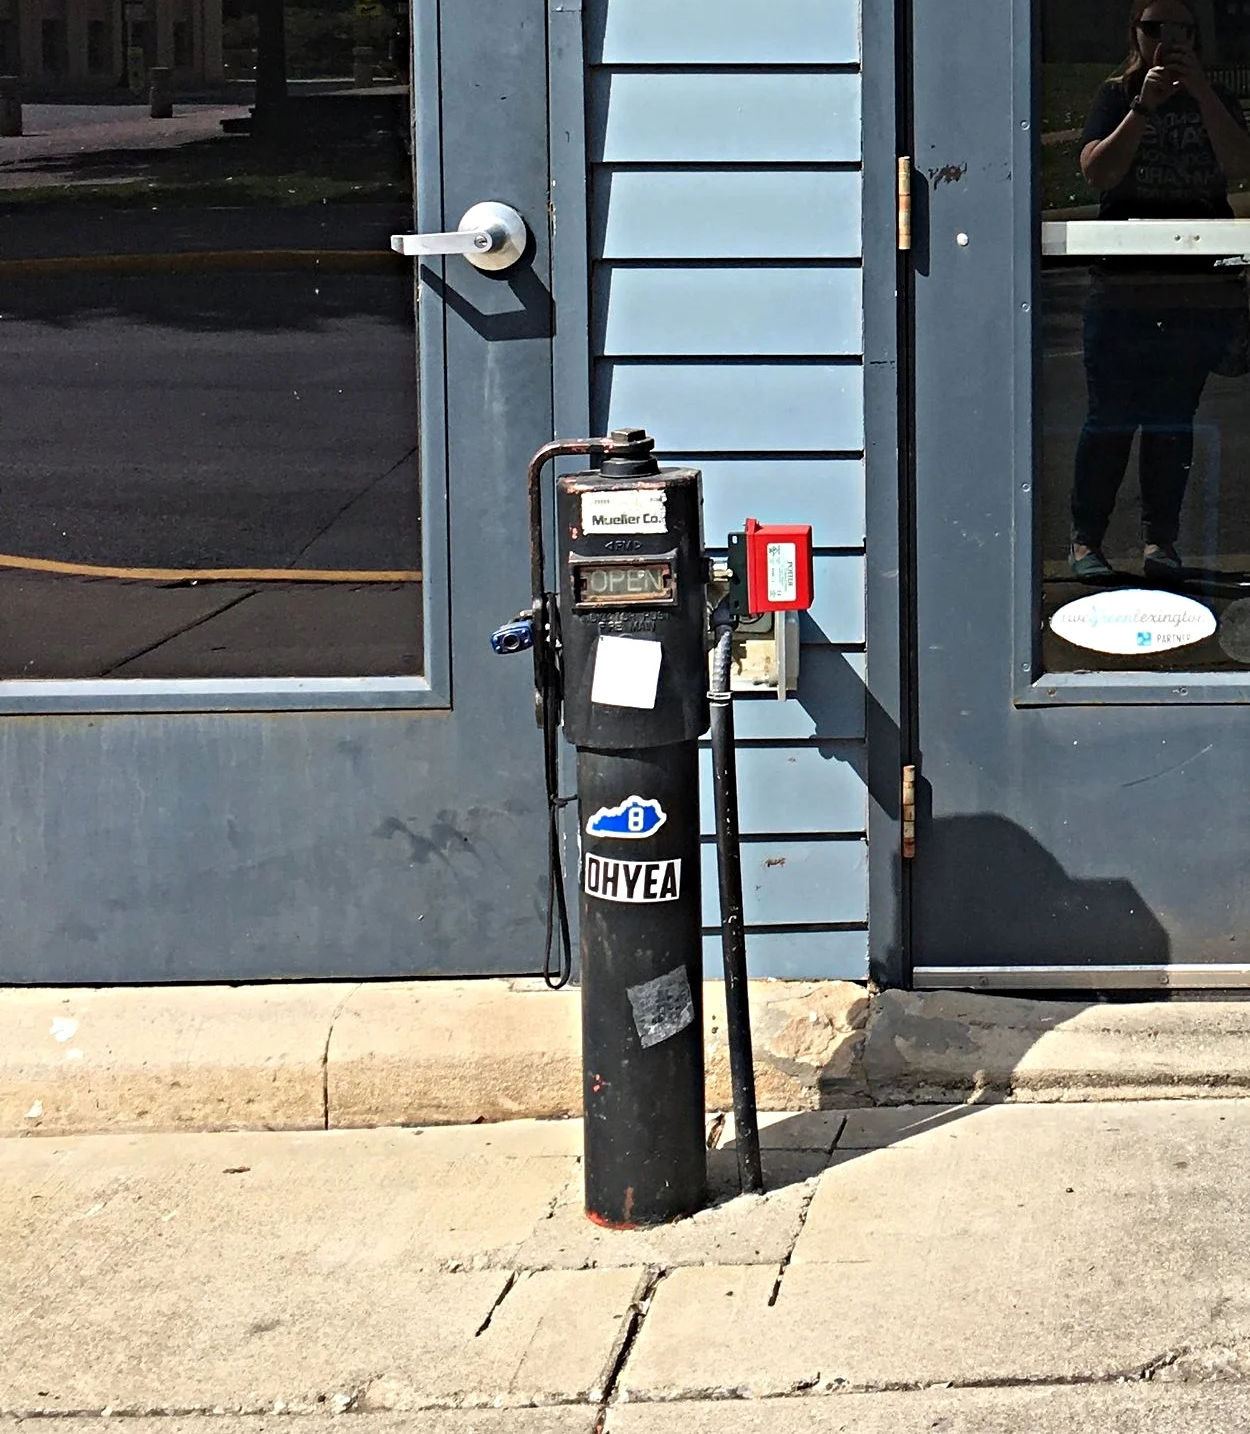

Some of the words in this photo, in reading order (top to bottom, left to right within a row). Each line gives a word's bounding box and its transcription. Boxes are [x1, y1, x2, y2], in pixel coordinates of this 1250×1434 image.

[592, 514, 640, 526] Mueller
[642, 514, 661, 524] Co.
[590, 570, 662, 592] OPEN
[1156, 634, 1192, 644] PARTNER
[628, 807, 644, 832] 8
